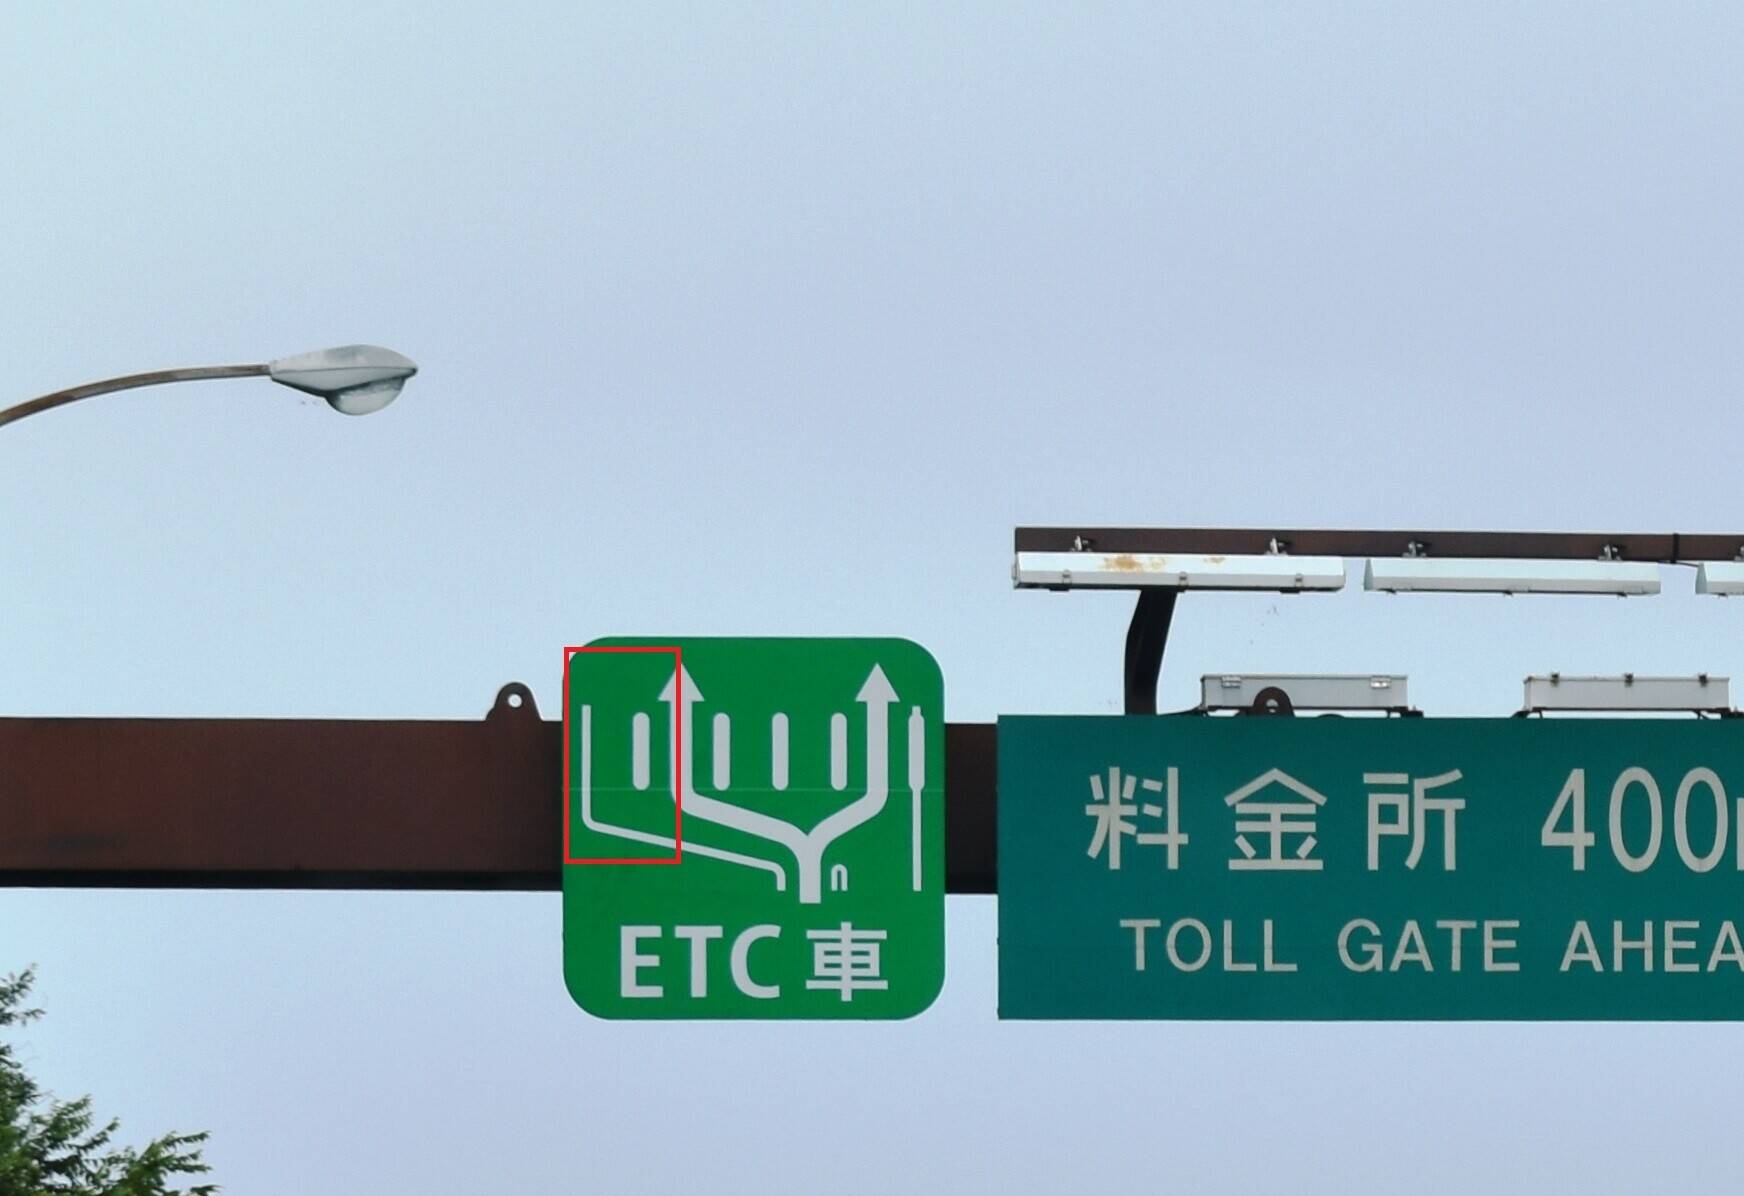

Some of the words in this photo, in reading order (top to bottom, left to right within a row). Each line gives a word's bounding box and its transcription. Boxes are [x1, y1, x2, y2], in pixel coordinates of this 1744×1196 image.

[1085, 766, 1467, 873] 料金所
[1120, 918, 1298, 973] TOLL
[1337, 918, 1521, 974] GATE
